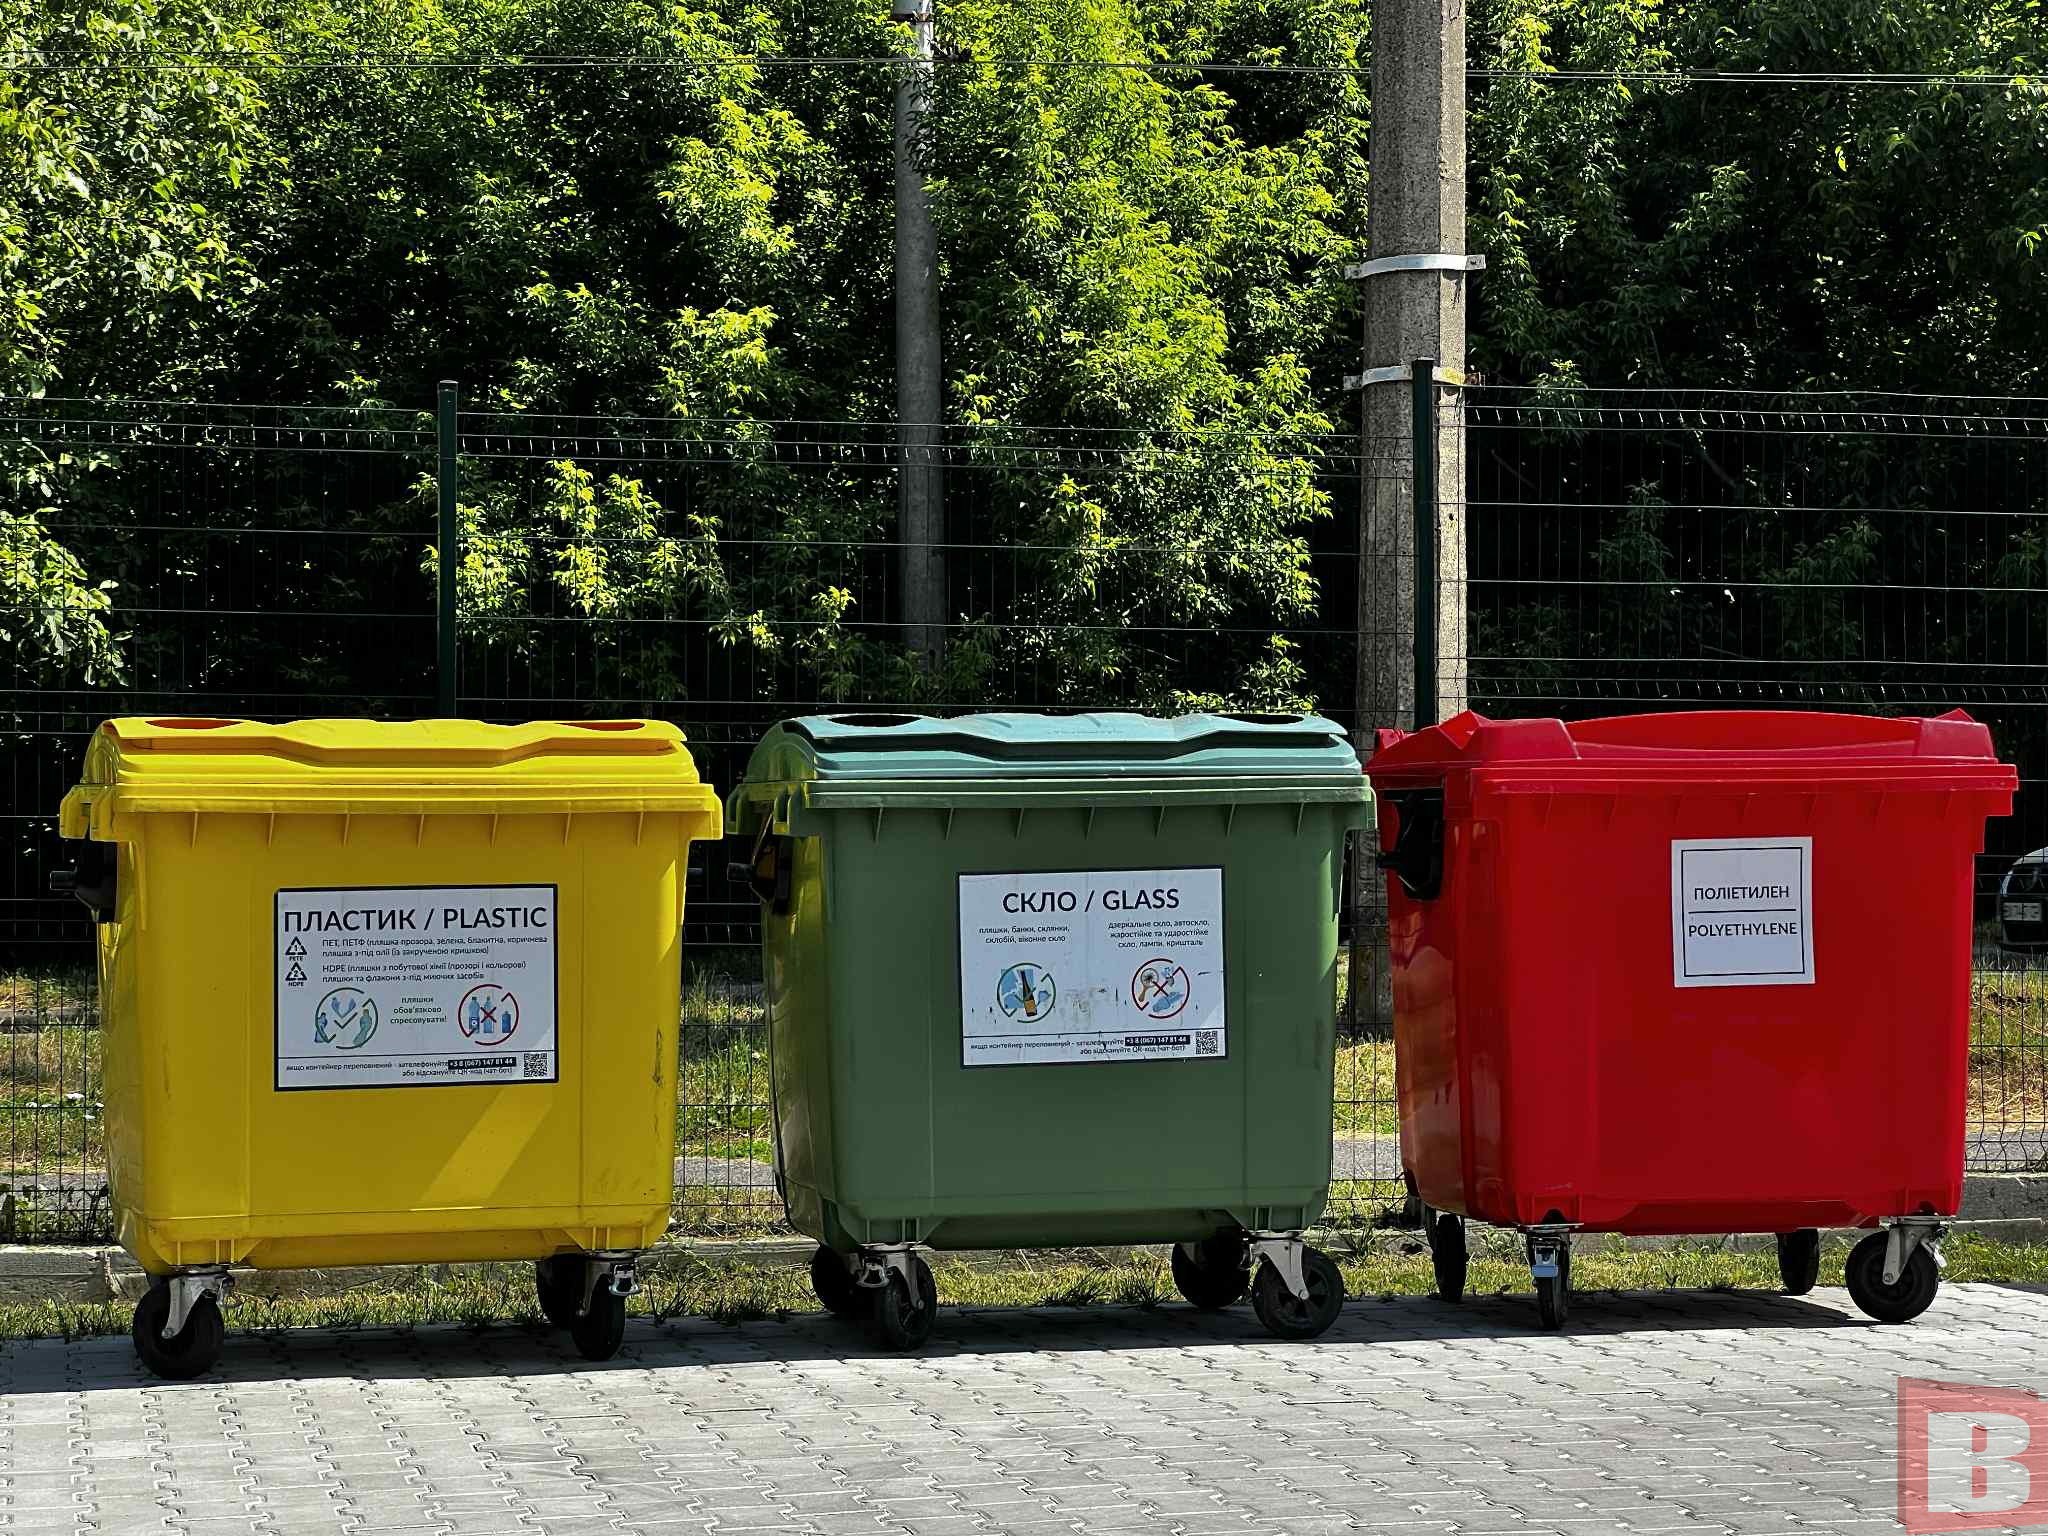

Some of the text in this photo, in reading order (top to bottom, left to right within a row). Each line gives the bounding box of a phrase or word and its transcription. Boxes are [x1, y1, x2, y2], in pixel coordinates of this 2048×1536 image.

[1694, 886, 1790, 900] ПОЛІЕТИЛЕН
[1002, 888, 1180, 913] СКЛО / GLASS
[284, 907, 547, 932] ПЛАСТИК / PLASTIC
[1108, 921, 1151, 929] дзеркальне
[1688, 922, 1798, 937] POLYETHYLENE
[1164, 929, 1209, 937] ударостійке
[342, 939, 366, 947] ПЕТФ
[1166, 939, 1204, 947] кришталь
[322, 964, 346, 972] HDPE
[388, 963, 428, 972] побутової
